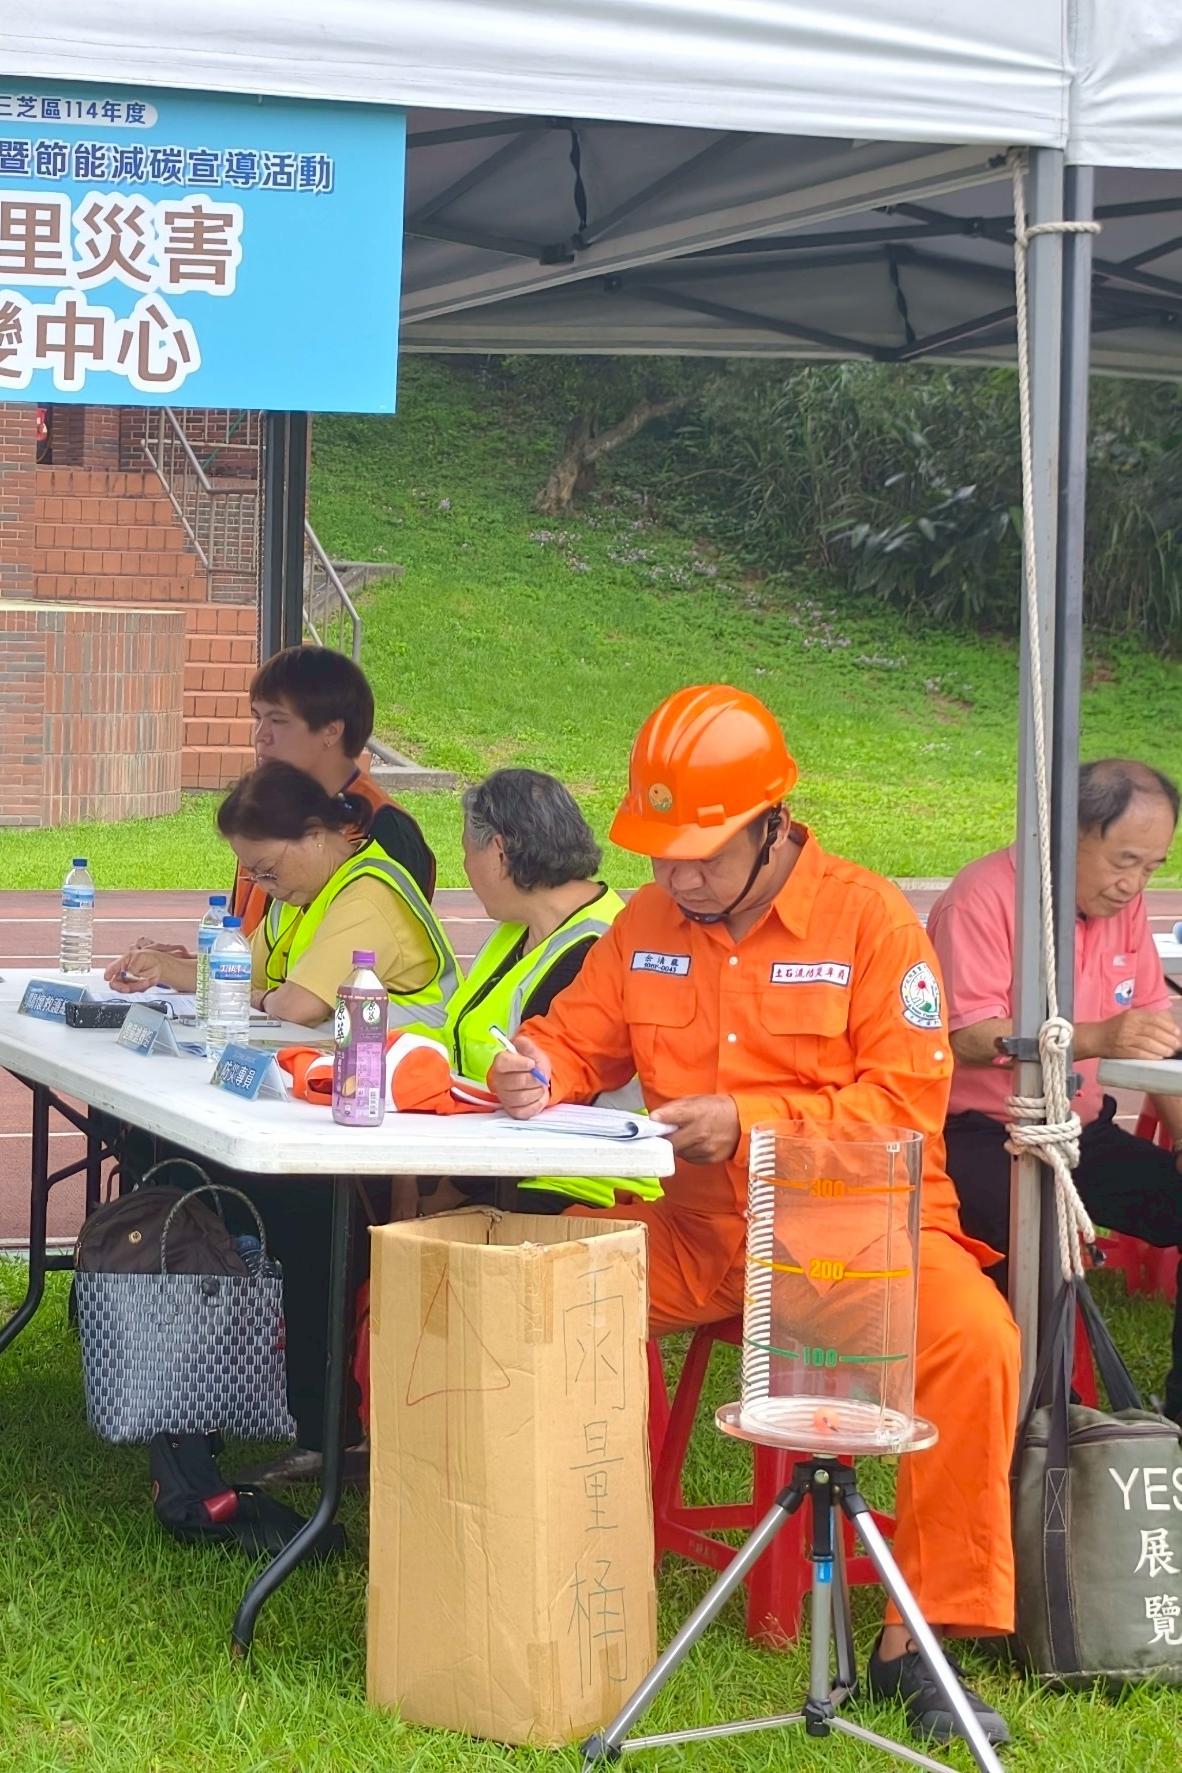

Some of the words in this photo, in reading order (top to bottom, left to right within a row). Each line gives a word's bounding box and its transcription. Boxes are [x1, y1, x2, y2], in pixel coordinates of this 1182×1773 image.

[219, 1060, 256, 1090] 防災專員
[809, 1179, 845, 1198] 300
[809, 1258, 844, 1280] 200
[802, 1347, 838, 1368] 100
[563, 1265, 628, 1699] 雨量桶
